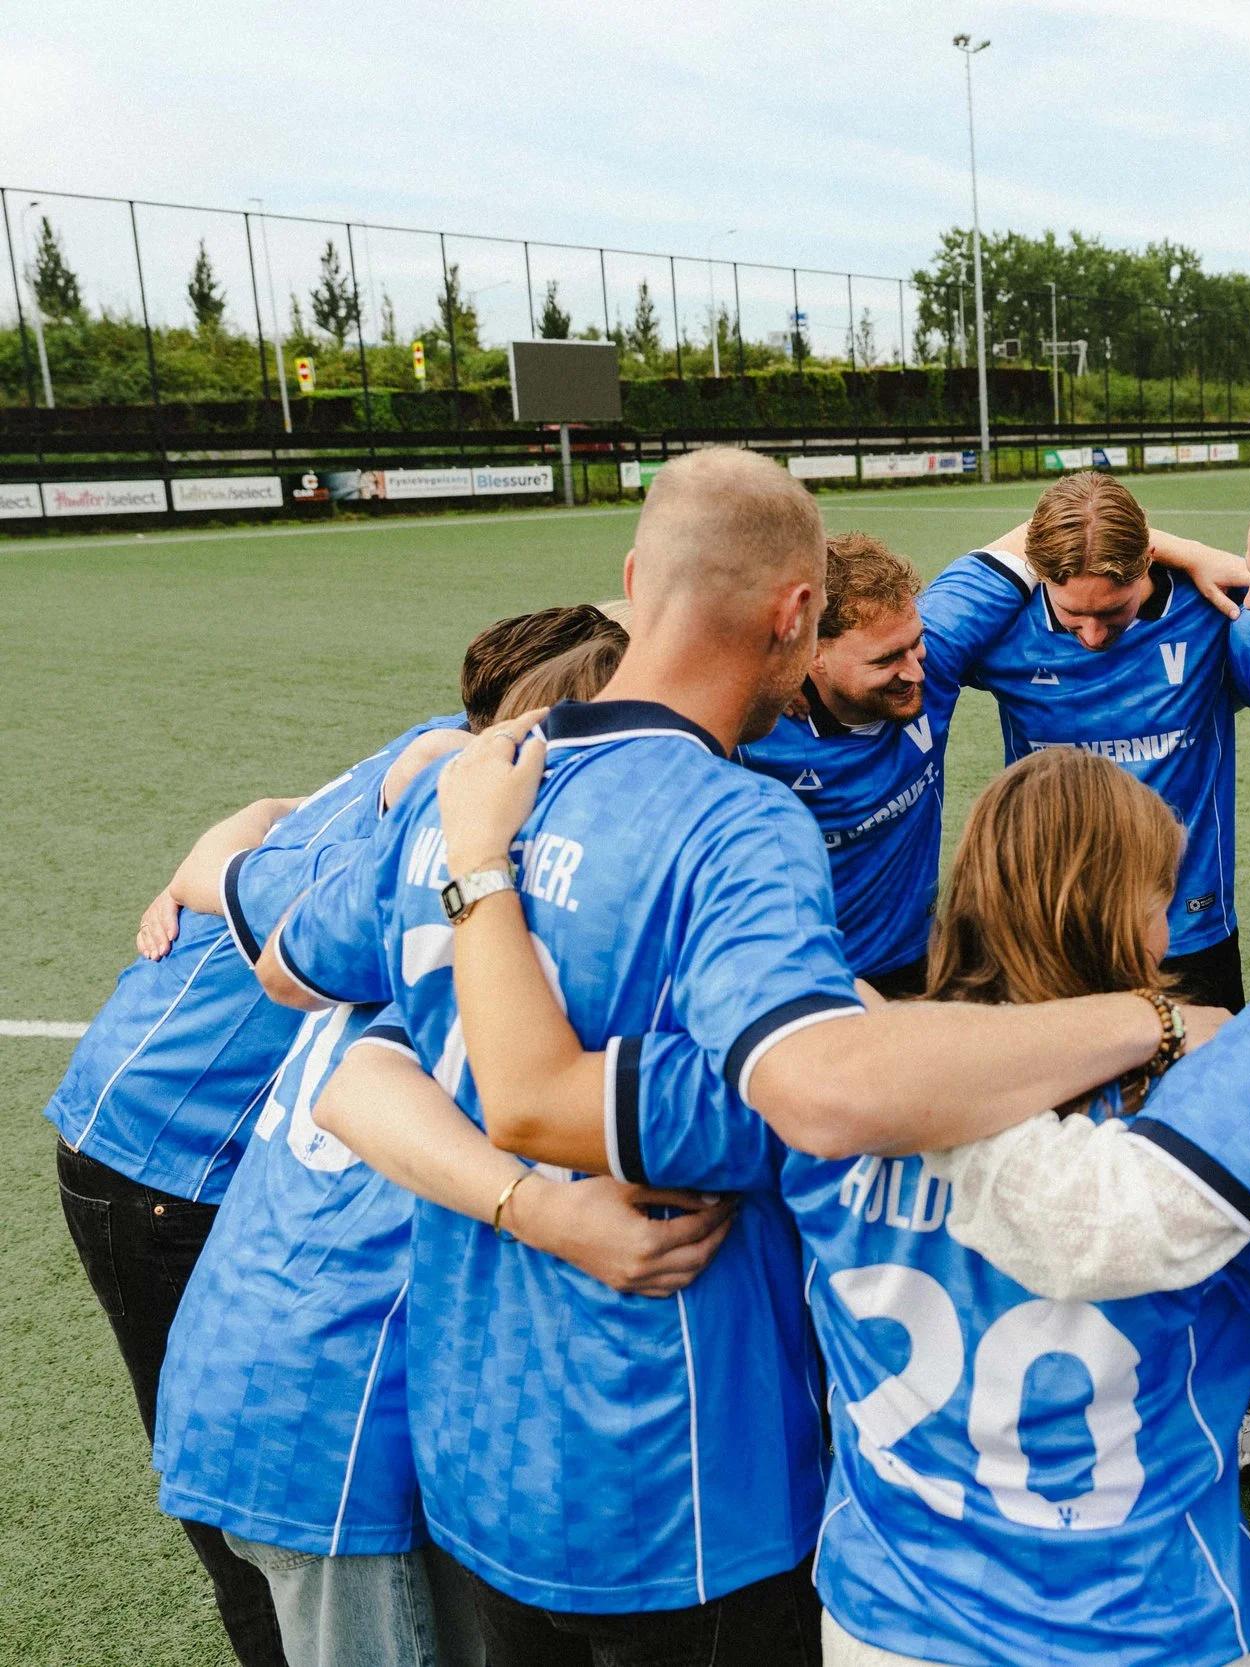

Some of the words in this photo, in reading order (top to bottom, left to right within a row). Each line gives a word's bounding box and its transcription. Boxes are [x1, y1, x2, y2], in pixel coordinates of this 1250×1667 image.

[477, 473, 549, 488] Blessure?
[1159, 642, 1187, 684] V
[903, 713, 934, 754] V
[829, 1263, 1145, 1531] 20
